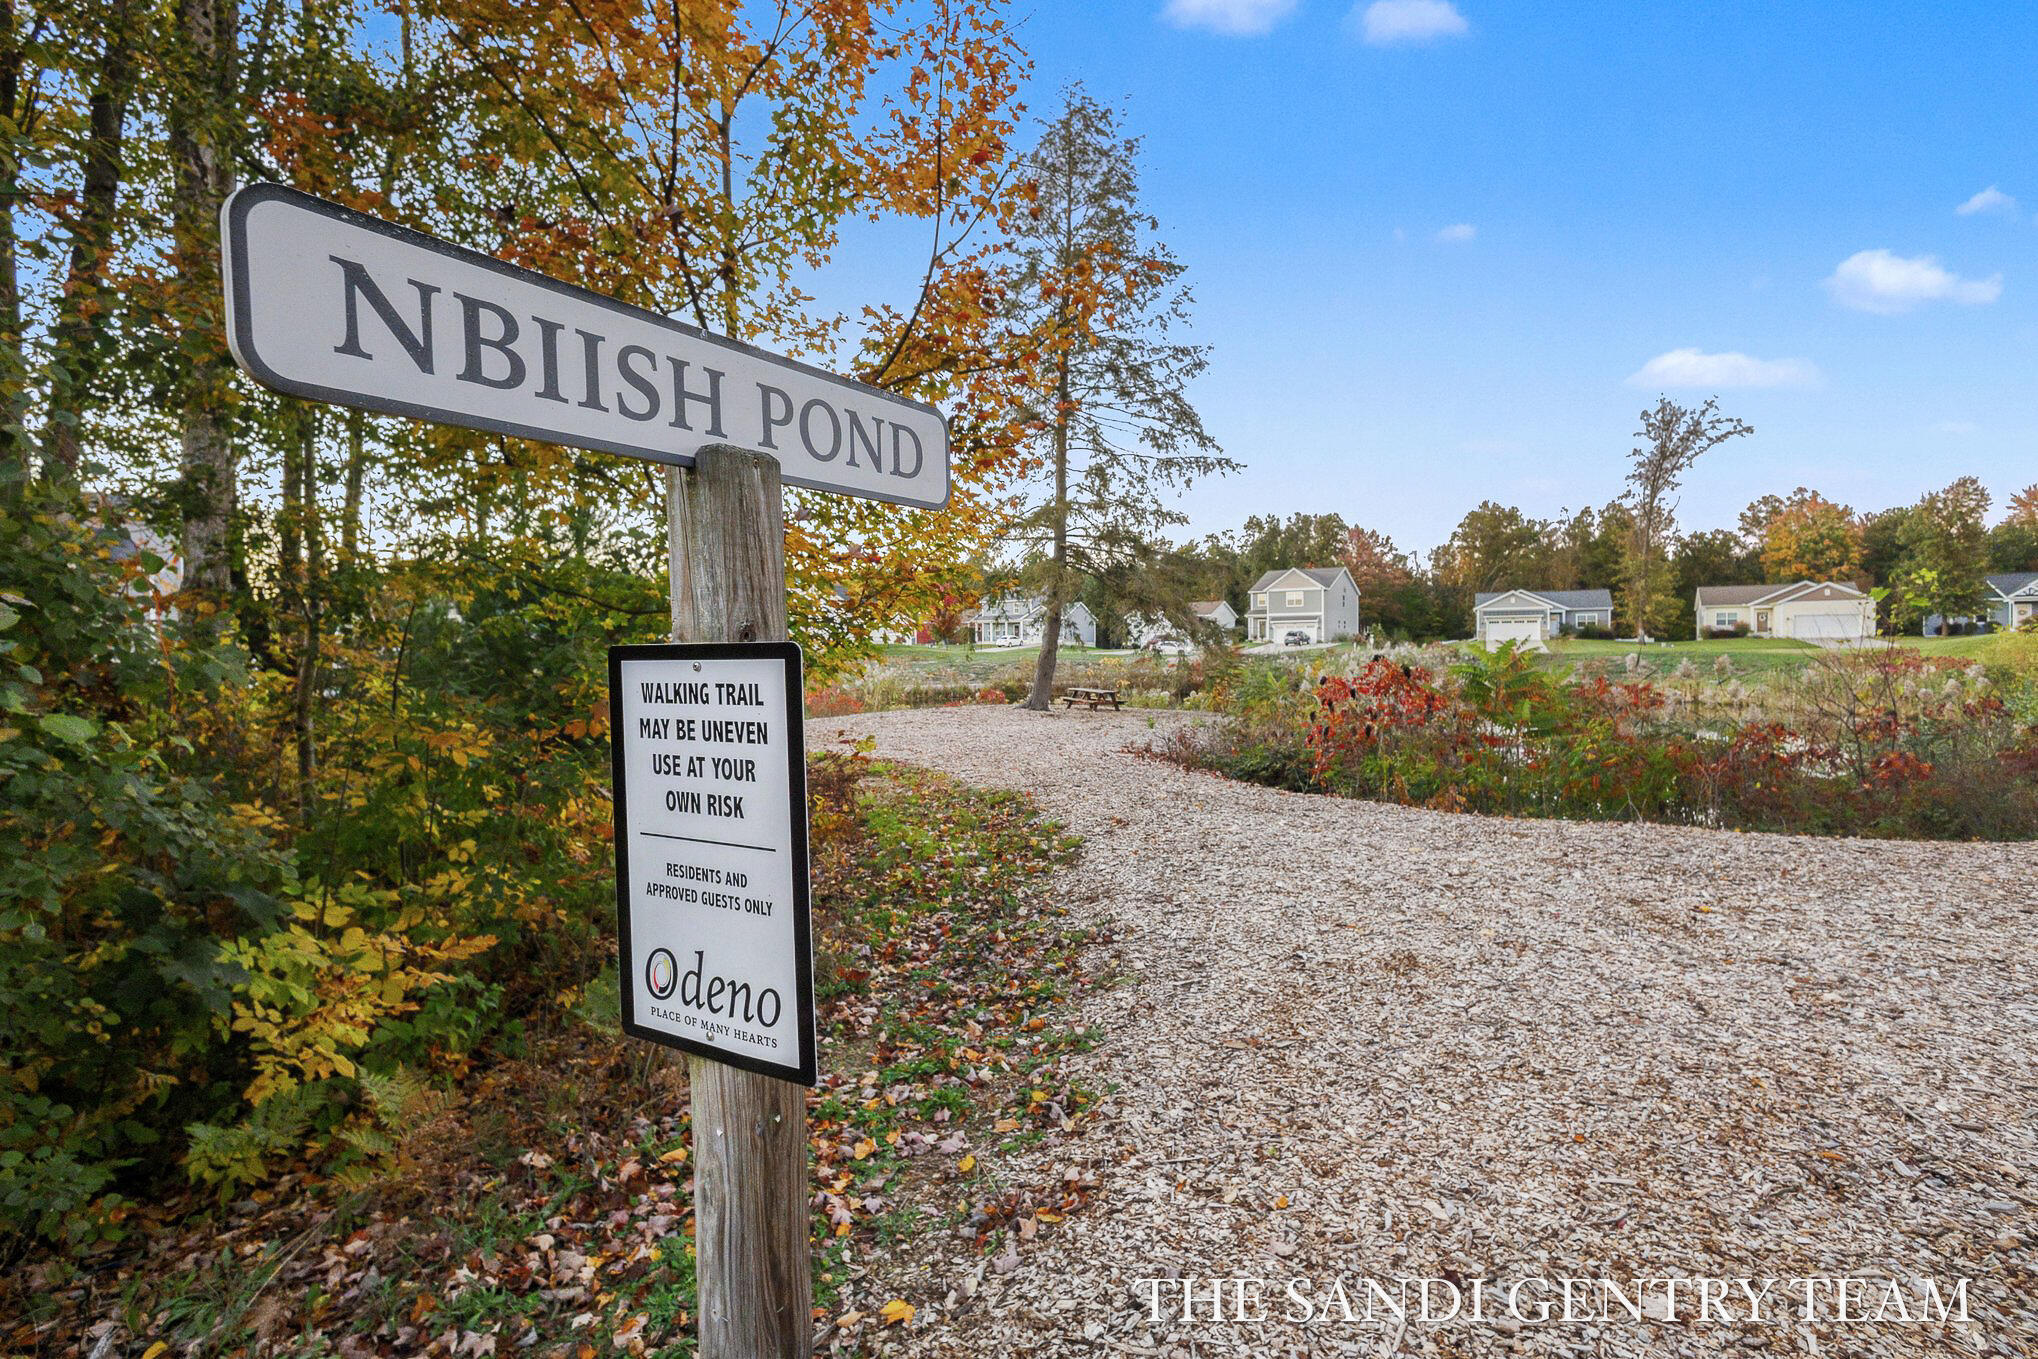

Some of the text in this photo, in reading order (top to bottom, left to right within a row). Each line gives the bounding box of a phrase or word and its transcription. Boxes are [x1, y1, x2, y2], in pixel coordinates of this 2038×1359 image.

[328, 254, 923, 479] NBIISH POND
[641, 682, 764, 706] WALKING TRAIL
[639, 718, 768, 745] MAY BE UNEVEN
[652, 753, 756, 782] USE AT YOUR
[666, 790, 744, 819] OWN RISK
[666, 862, 748, 888] RESIDENTS AND
[646, 882, 772, 917] APPROVED GUESTS ONLY
[645, 947, 781, 1028] Odeno
[651, 1006, 778, 1048] PLACE OF MANY HEARTS
